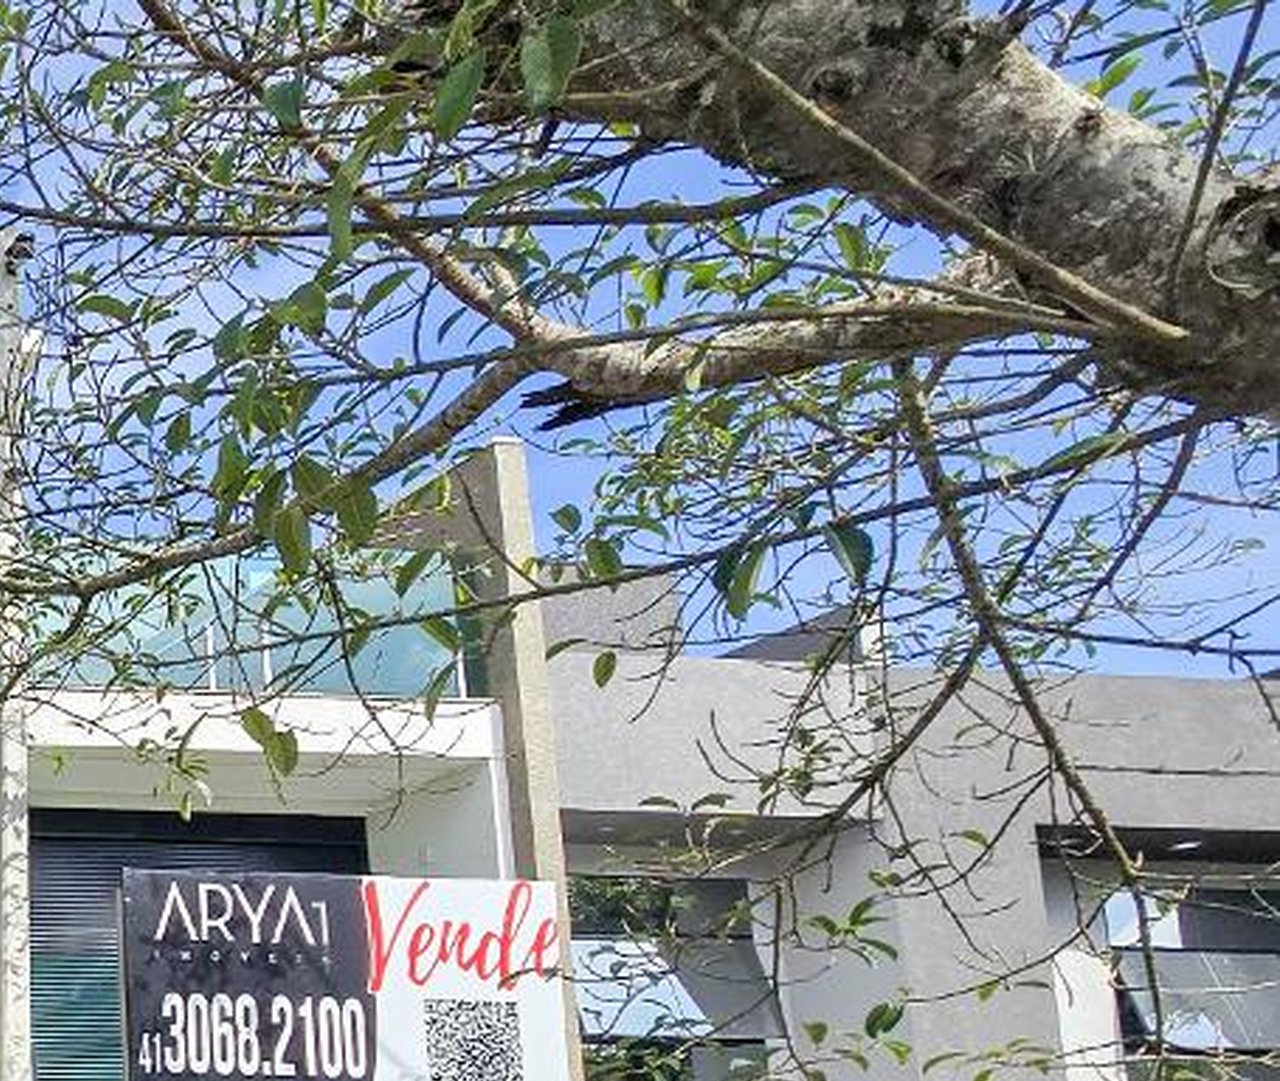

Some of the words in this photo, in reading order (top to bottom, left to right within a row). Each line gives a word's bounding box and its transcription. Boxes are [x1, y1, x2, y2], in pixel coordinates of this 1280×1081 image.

[363, 880, 559, 991] Vende
[138, 1033, 162, 1074] 41
[161, 992, 366, 1079] 3068.2100
